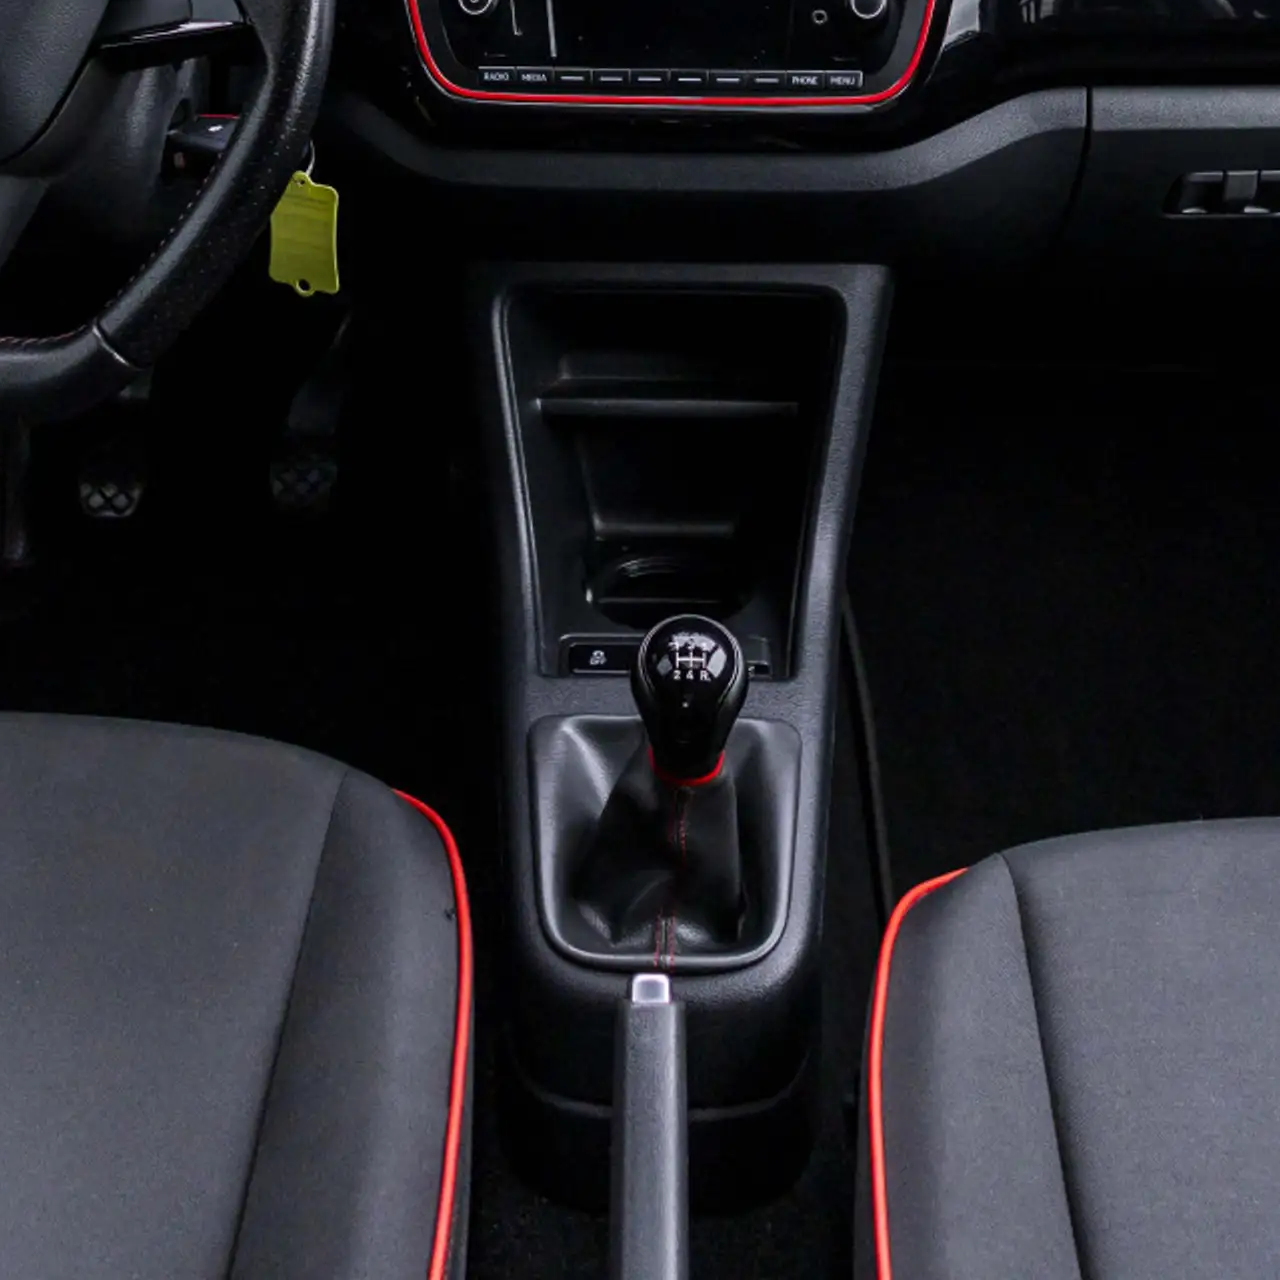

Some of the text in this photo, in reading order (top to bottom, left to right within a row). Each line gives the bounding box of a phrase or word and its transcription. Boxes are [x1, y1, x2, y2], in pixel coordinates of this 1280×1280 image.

[483, 72, 511, 82] RADIO
[521, 73, 548, 83] MEDIA
[673, 669, 681, 680] 2
[685, 669, 695, 680] 4
